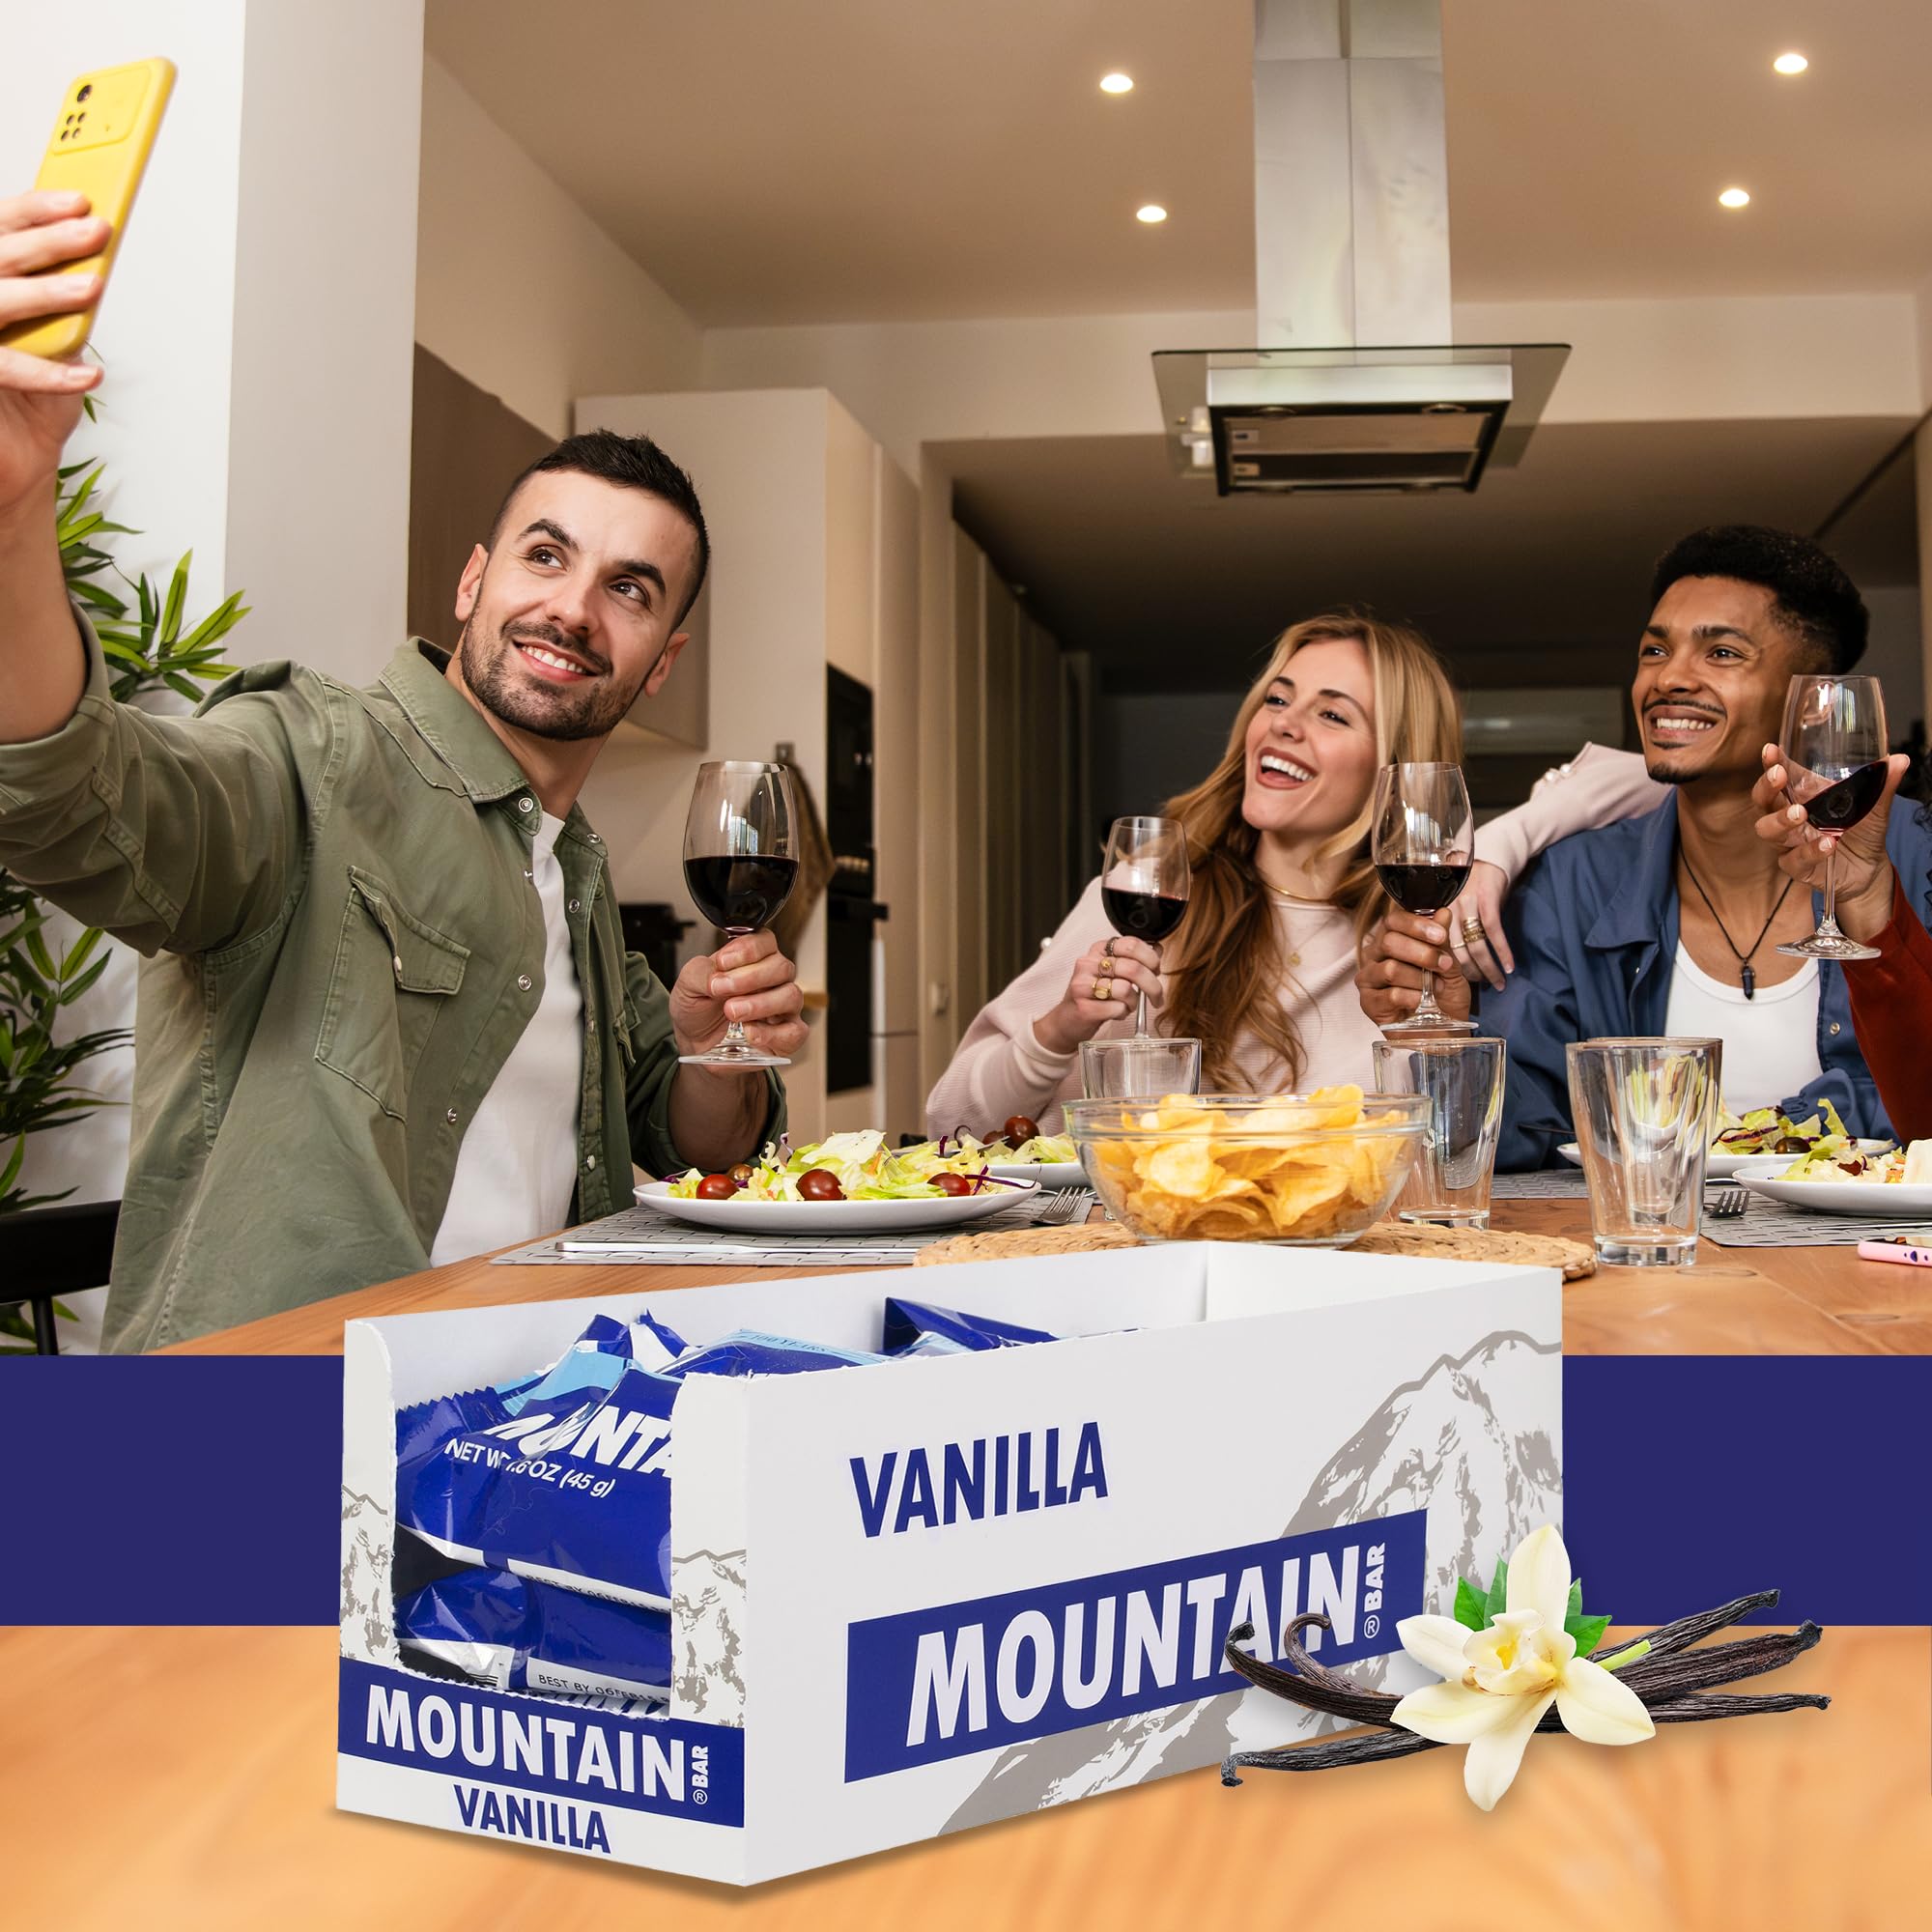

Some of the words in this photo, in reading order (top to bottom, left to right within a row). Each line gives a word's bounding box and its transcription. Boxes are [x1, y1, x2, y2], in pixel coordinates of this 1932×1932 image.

[444, 1437, 486, 1463] NET
[528, 1461, 562, 1483] OZ
[559, 1468, 595, 1490] (45
[590, 1478, 616, 1498] g)
[850, 1422, 1108, 1538] VANILLA
[538, 1674, 569, 1690] BEST
[574, 1682, 590, 1694] BY
[906, 1545, 1360, 1747] MOUNTAIN
[365, 1684, 685, 1803] MOUNTAIN
[453, 1783, 611, 1854] VANILLA
